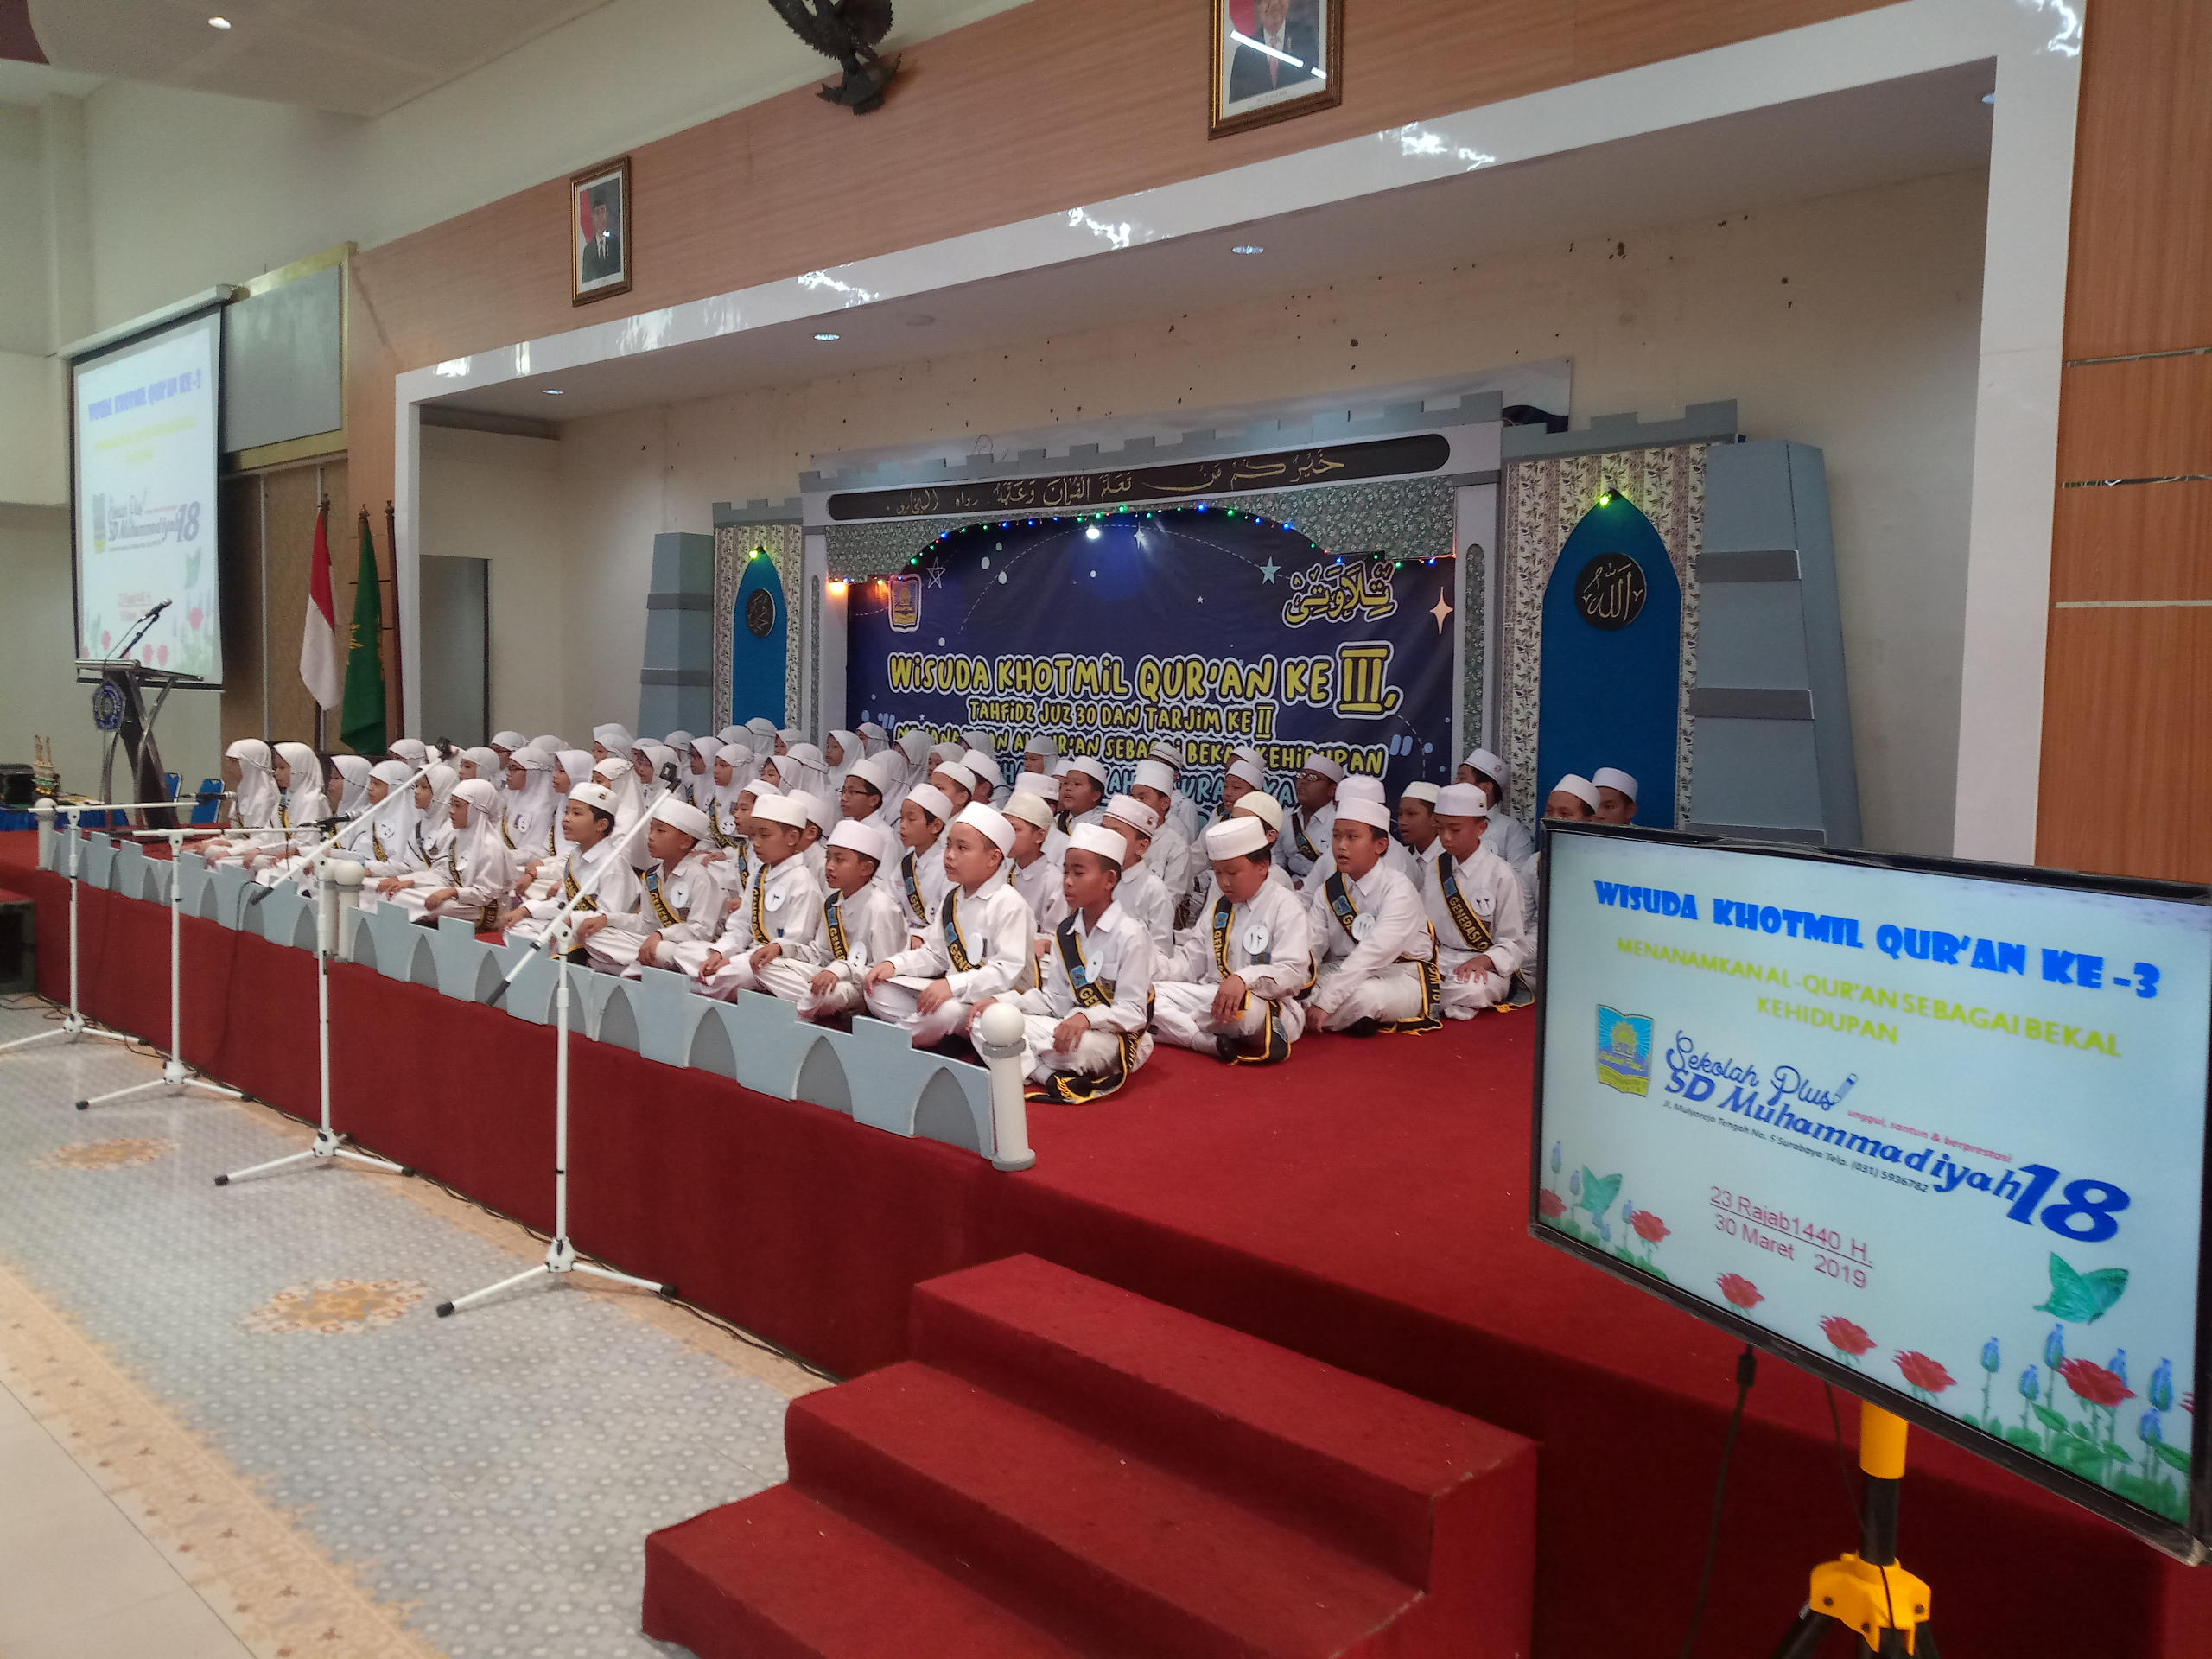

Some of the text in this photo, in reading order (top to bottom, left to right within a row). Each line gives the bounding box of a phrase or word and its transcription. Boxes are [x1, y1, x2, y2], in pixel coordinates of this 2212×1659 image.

[1138, 659, 1274, 702] QUR'AN
[1285, 662, 1330, 702] KE
[1039, 702, 1071, 724] JUZ
[1076, 704, 1098, 724] 30
[1103, 704, 1141, 728] DAN
[1227, 709, 1252, 731] KE
[1255, 704, 1274, 740] II
[1186, 741, 1235, 764] BEKA
[1449, 897, 1483, 943] GENERASI
[1593, 880, 1699, 920] WISUDA
[1712, 898, 1865, 949] KHOTMIL
[1876, 924, 2027, 976] QUR'AN
[1617, 937, 1764, 981] MENANAMKAN
[1901, 993, 2020, 1035] SEBAGAI
[2023, 1016, 2122, 1058] BEKAL
[1757, 995, 1898, 1045] KEHIDUPAN
[1666, 1029, 1760, 1087] Sekolah
[1664, 1069, 2131, 1243] SD Muhammadiyah 18
[1777, 1136, 1824, 1159] Surabaya
[1710, 1185, 1733, 1208] 23
[1713, 1212, 1868, 1289] 30 Maret 2019
